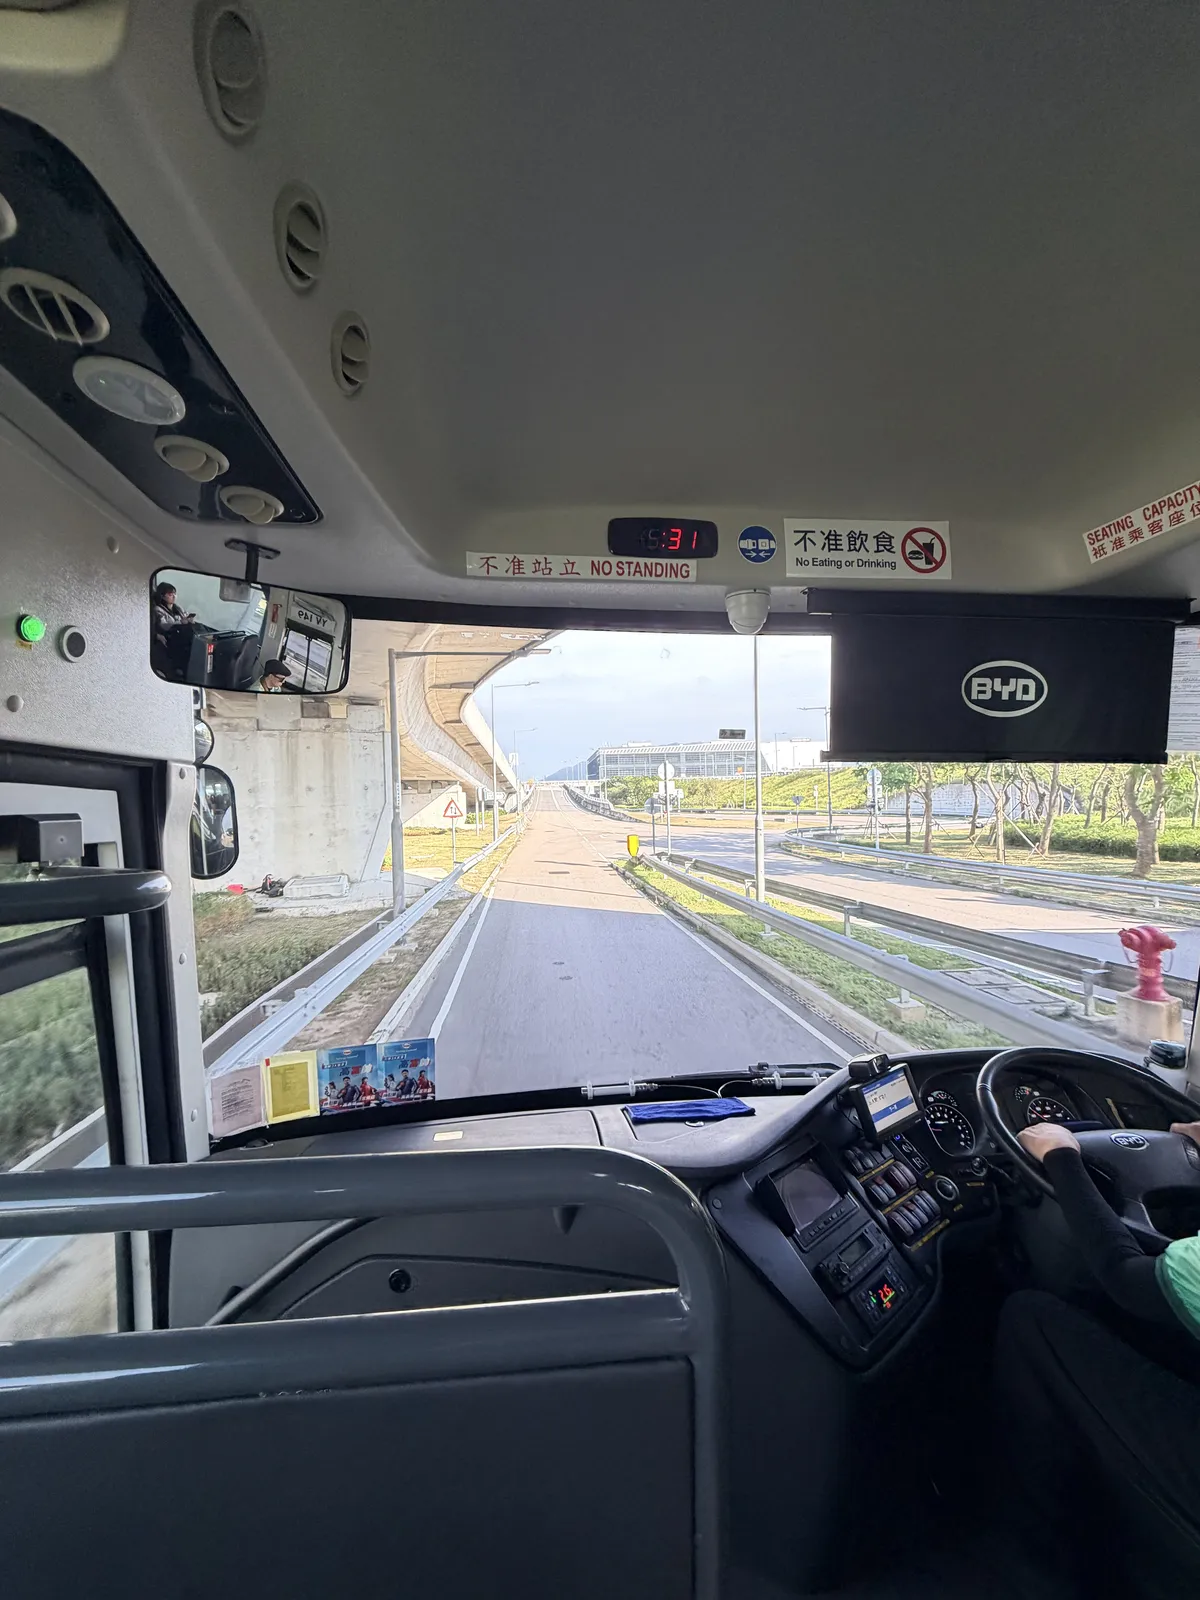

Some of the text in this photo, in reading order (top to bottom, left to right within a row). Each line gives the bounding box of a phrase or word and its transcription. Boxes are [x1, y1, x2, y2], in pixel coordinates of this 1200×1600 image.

[793, 529, 896, 555] 不准飲食
[1086, 515, 1134, 546] SEATING
[479, 555, 581, 577] 不准站立
[590, 559, 691, 579] NO STANDING
[795, 557, 897, 571] No Eating or Drinking
[971, 677, 1036, 701] BYD
